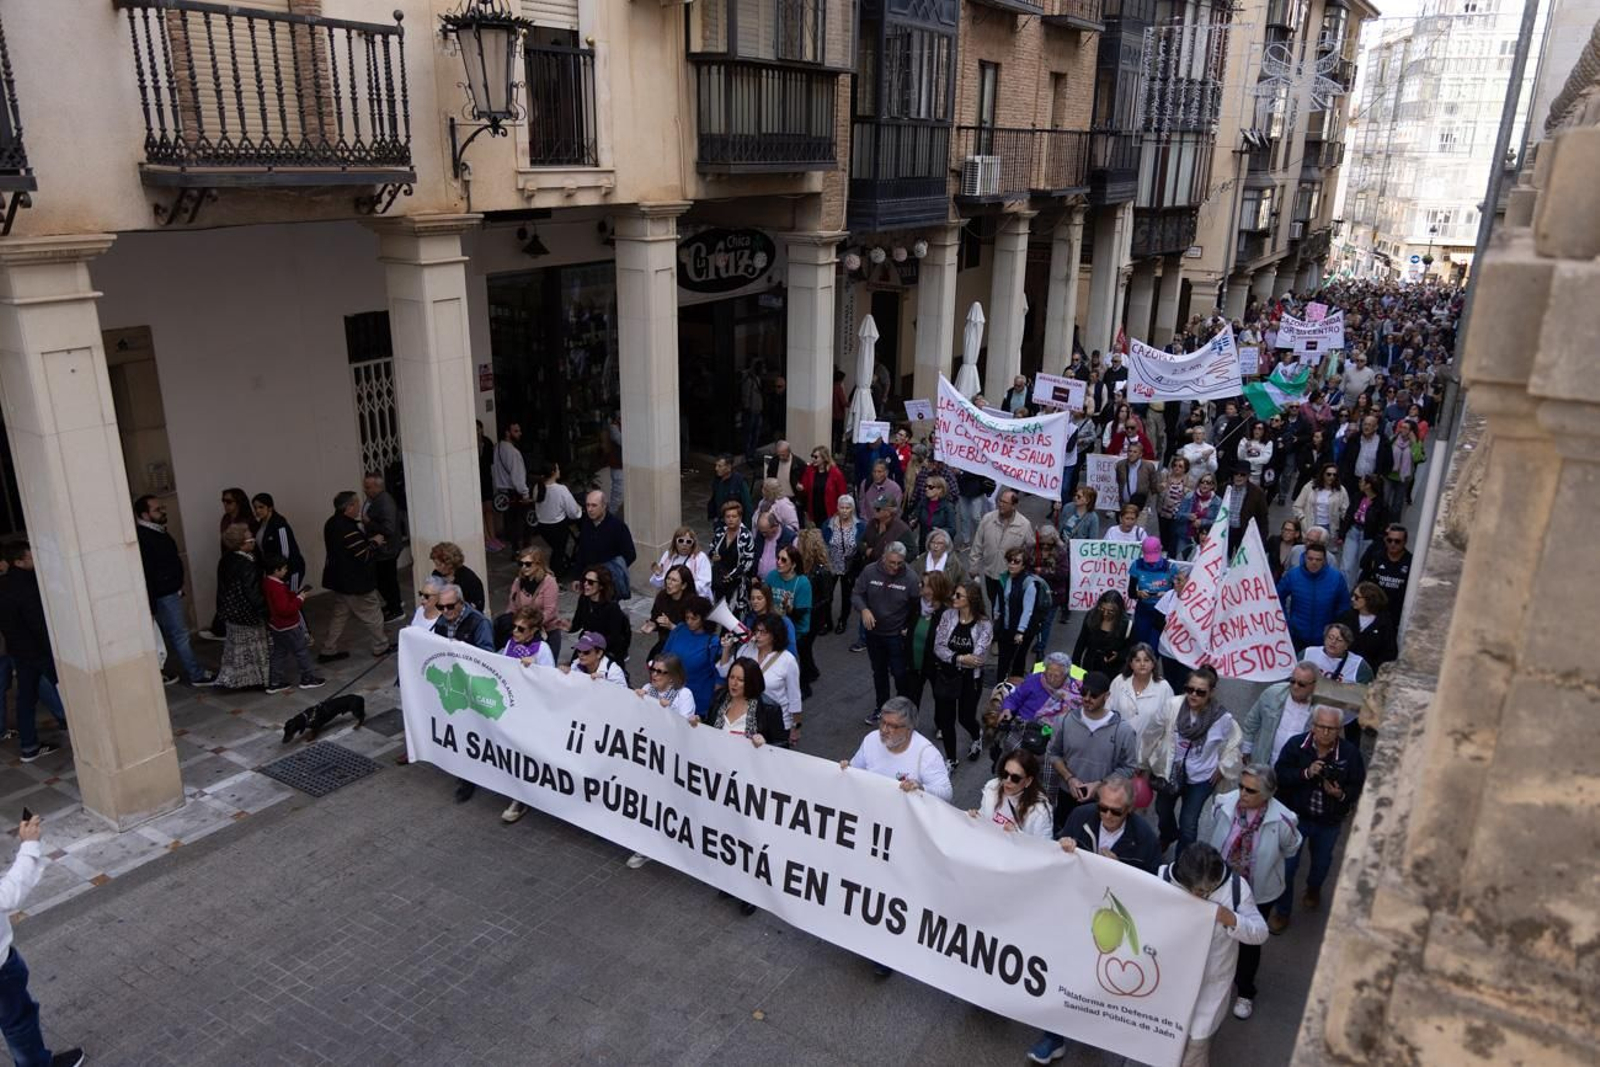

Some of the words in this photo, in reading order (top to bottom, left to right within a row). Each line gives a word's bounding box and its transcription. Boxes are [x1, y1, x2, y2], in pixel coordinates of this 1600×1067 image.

[945, 439, 988, 464] PUEBLO
[1001, 443, 1015, 458] DE
[1016, 447, 1056, 468] SALUD
[1079, 577, 1090, 588] A
[1096, 577, 1127, 588] LOS
[1221, 572, 1278, 610] RURAL
[594, 723, 666, 775] JAÉN
[673, 752, 860, 851] LEVÁNTATE
[870, 822, 894, 862] !!
[430, 716, 459, 753] LA
[466, 730, 575, 797] SANIDAD
[583, 775, 695, 850] PÚBLICA
[701, 825, 773, 887] ESTÁ
[783, 860, 830, 906] EN
[840, 878, 909, 936] TUS
[917, 907, 1049, 998] MANOS
[1057, 985, 1105, 1009] Plataforma
[1107, 1002, 1119, 1011] en
[1121, 1005, 1159, 1023] Defensa
[1161, 1015, 1173, 1027] de
[1174, 1021, 1184, 1032] la
[1063, 1000, 1101, 1017] Sanidad
[1102, 1010, 1137, 1028] Pública
[1138, 1021, 1151, 1031] de
[1152, 1024, 1176, 1040] Jaén
